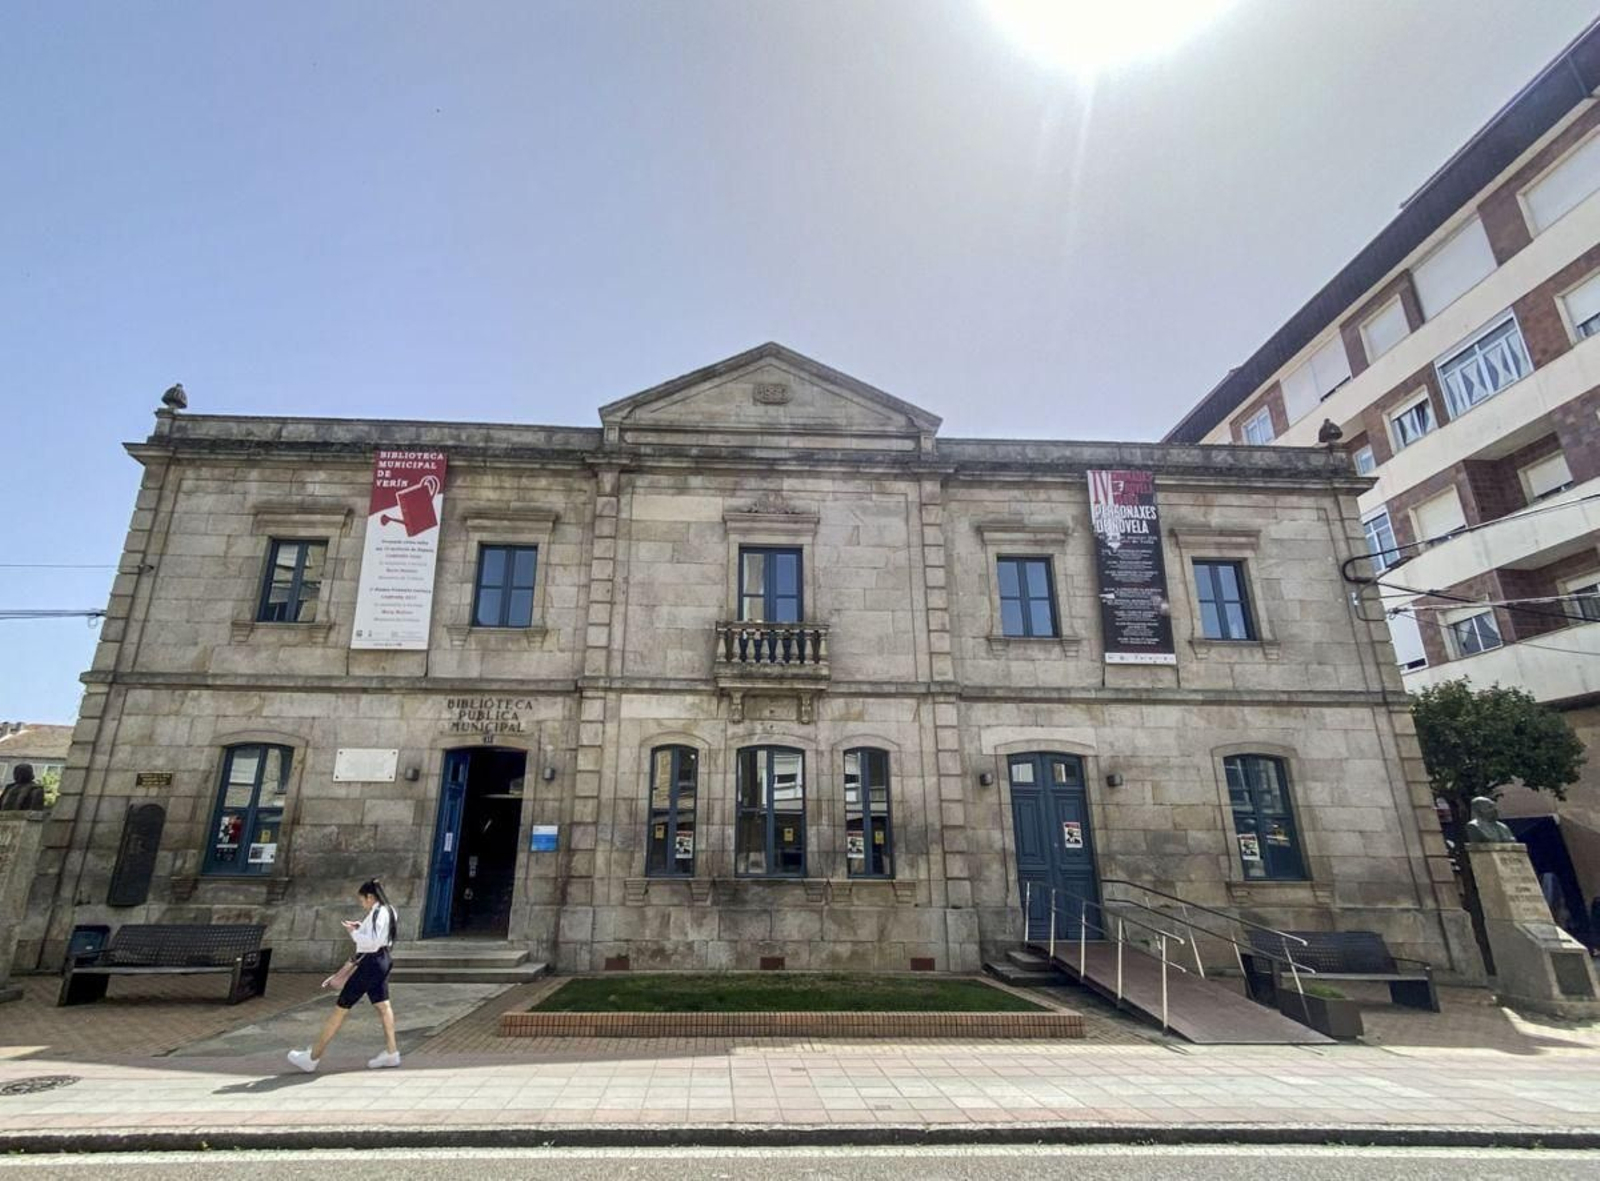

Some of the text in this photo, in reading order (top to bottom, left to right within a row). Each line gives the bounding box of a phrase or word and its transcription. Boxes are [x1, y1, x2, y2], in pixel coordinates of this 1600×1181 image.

[380, 451, 444, 460] BIBLIOTECA
[378, 461, 437, 469] MUNICIPAL
[376, 478, 408, 487] VERÍN
[459, 710, 519, 721] PUBLICA
[452, 721, 525, 733] MUNICIPAL
